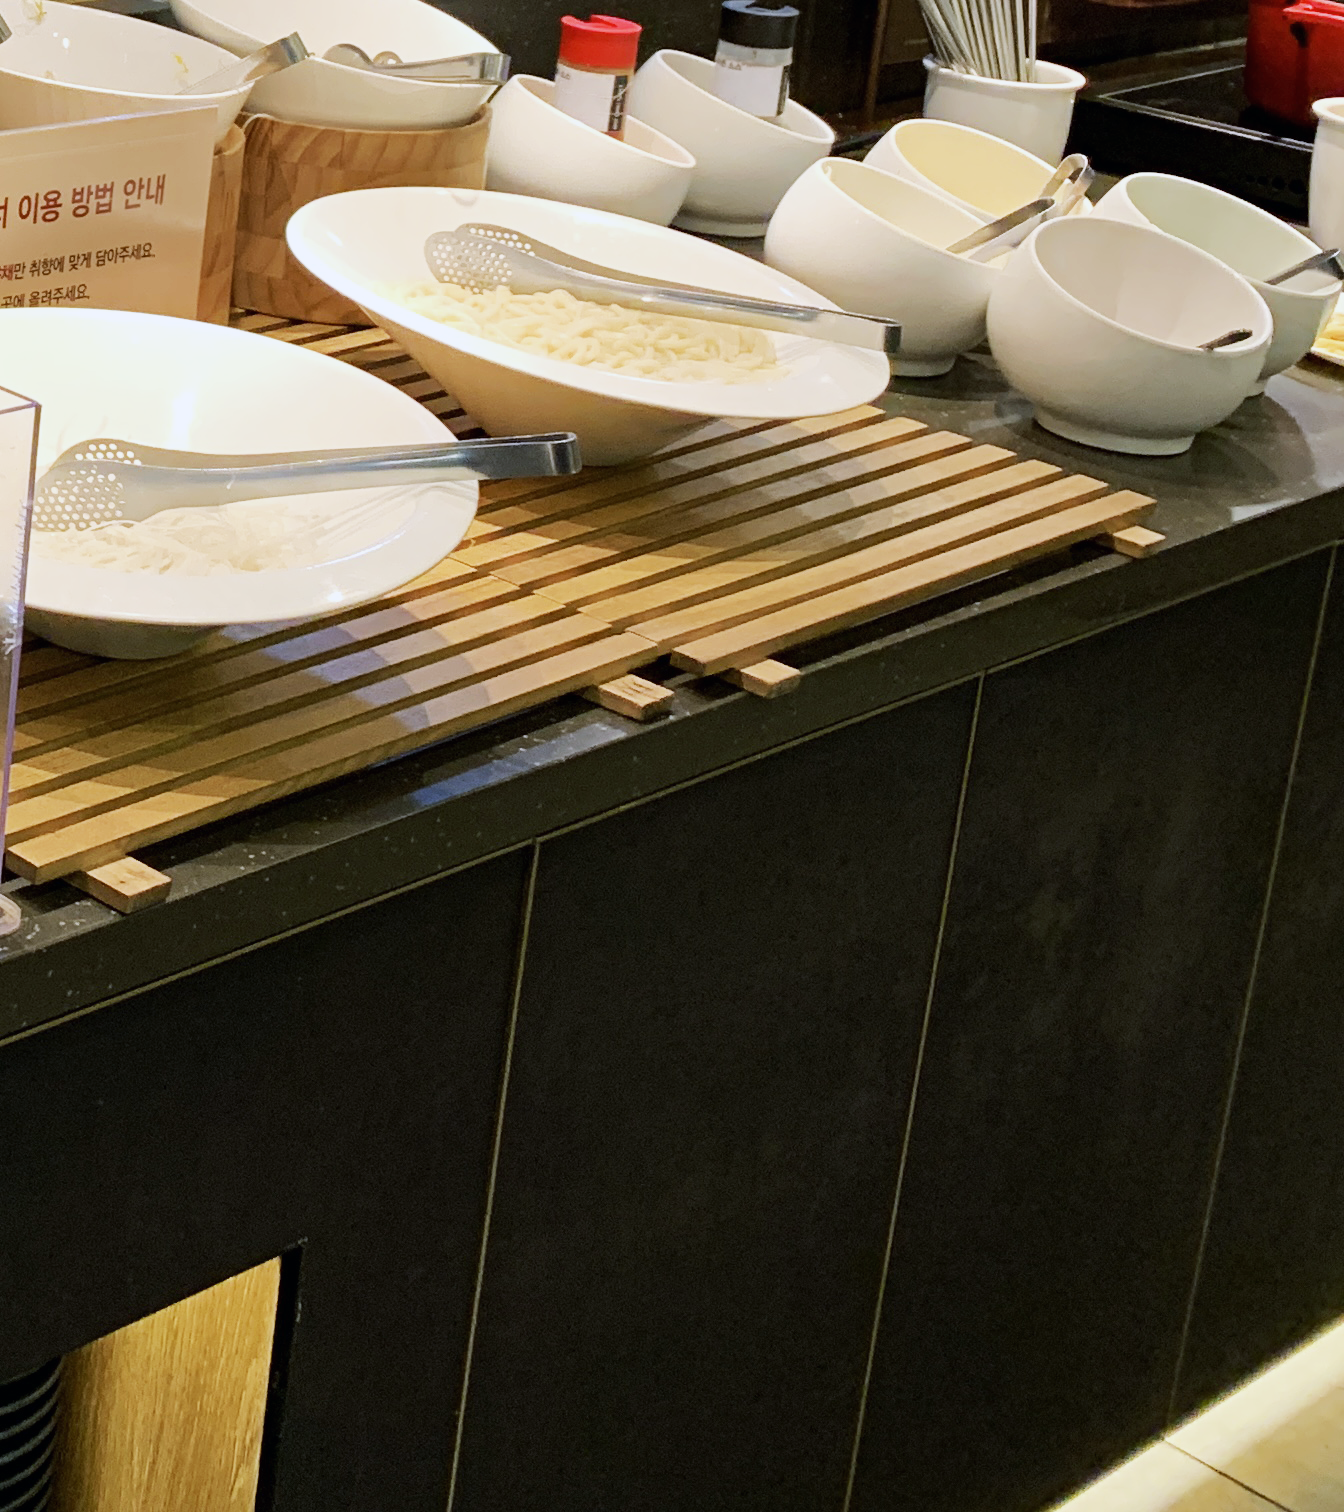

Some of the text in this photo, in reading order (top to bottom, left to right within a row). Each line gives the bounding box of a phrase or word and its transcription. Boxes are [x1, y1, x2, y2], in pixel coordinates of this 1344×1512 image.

[18, 189, 63, 224] 이용
[71, 181, 115, 219] 방법
[122, 173, 167, 209] 안내
[29, 256, 65, 277] 취향에
[69, 251, 92, 271] 맞게
